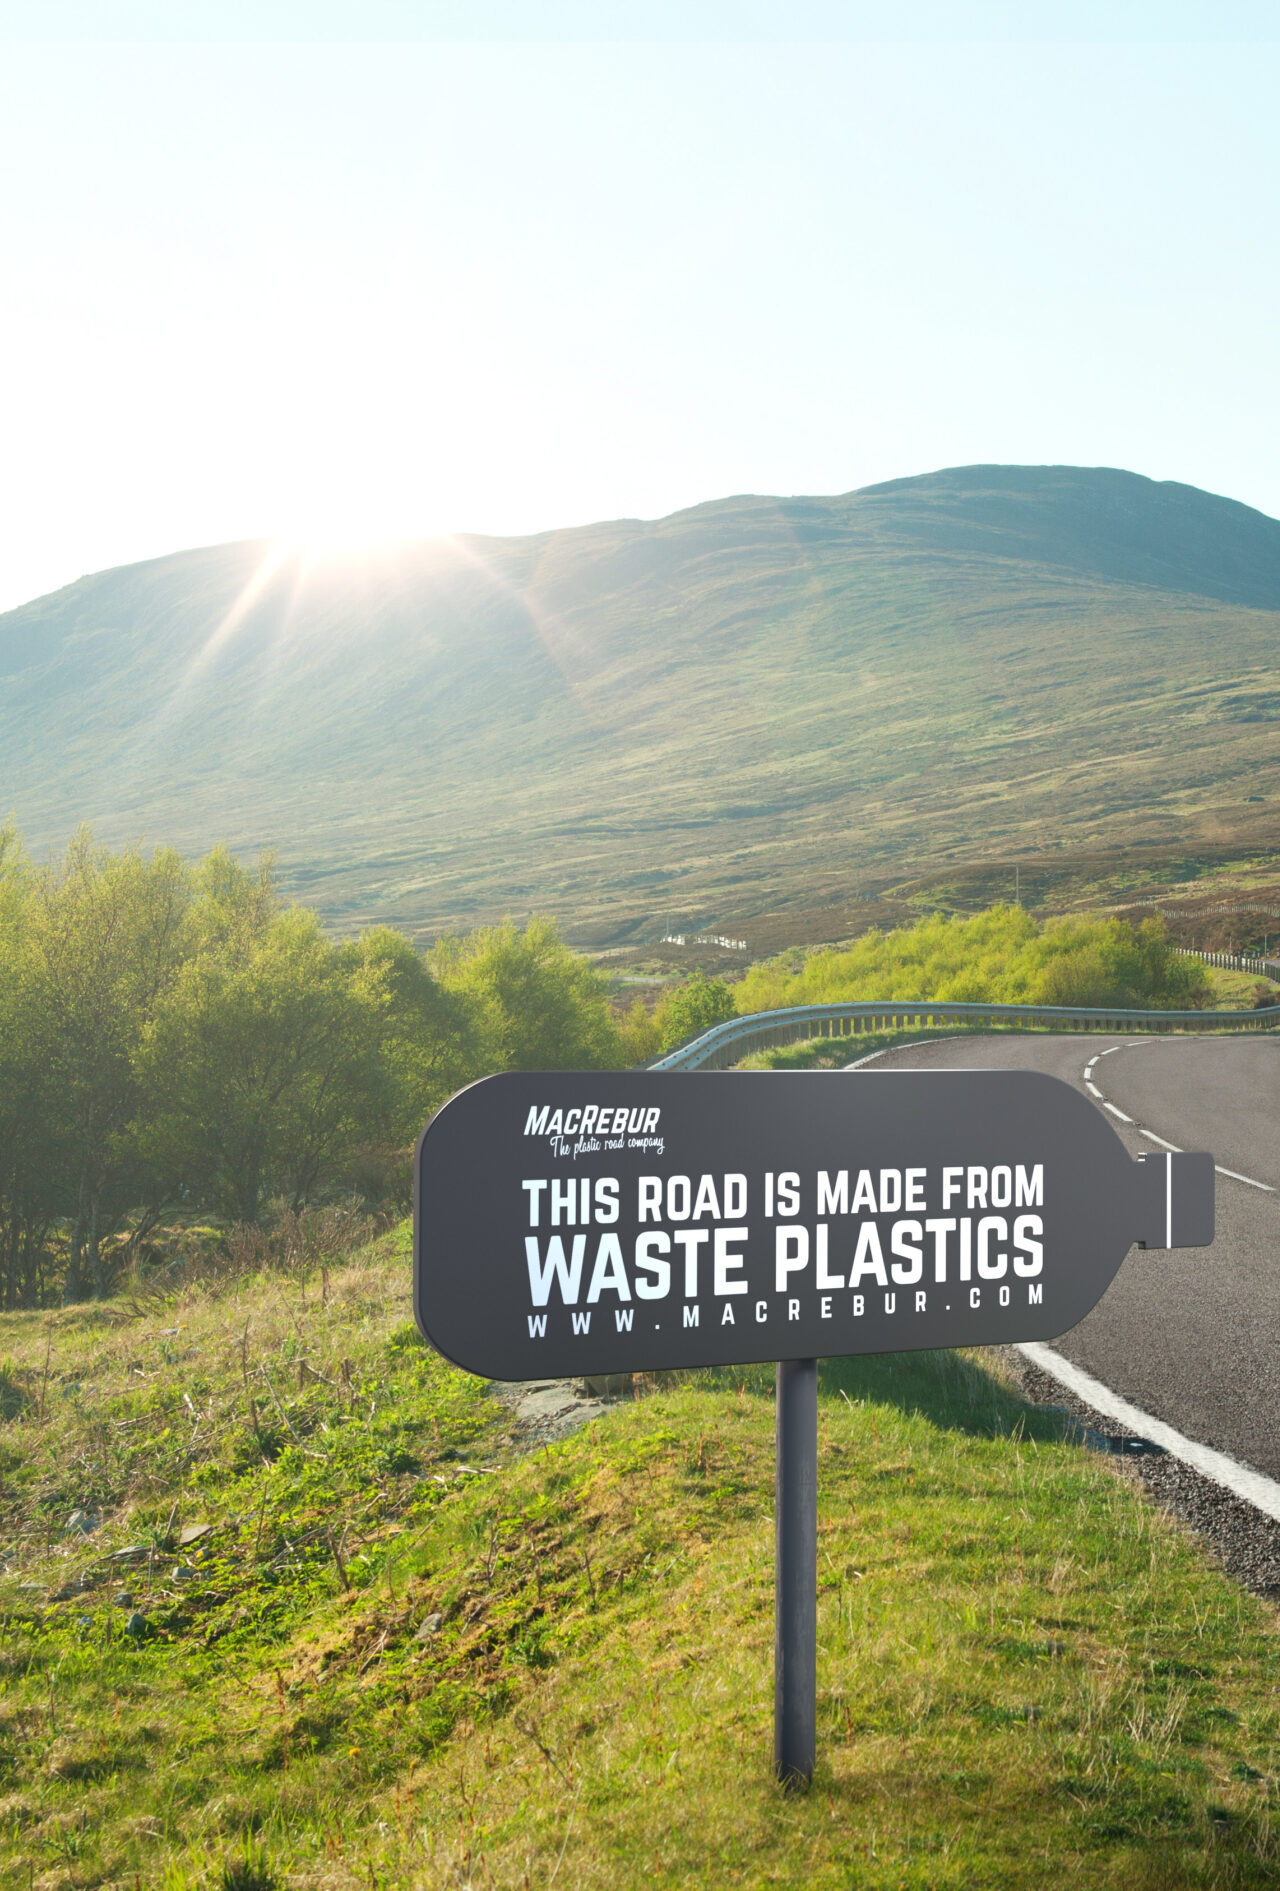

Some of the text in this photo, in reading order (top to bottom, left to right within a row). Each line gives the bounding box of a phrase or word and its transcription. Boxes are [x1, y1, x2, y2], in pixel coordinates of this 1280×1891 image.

[550, 1133, 665, 1160] The plastic road company
[522, 1163, 1044, 1227] THIS ROAD IS MADE FROM
[524, 1214, 1044, 1307] WASTE PLASTICS
